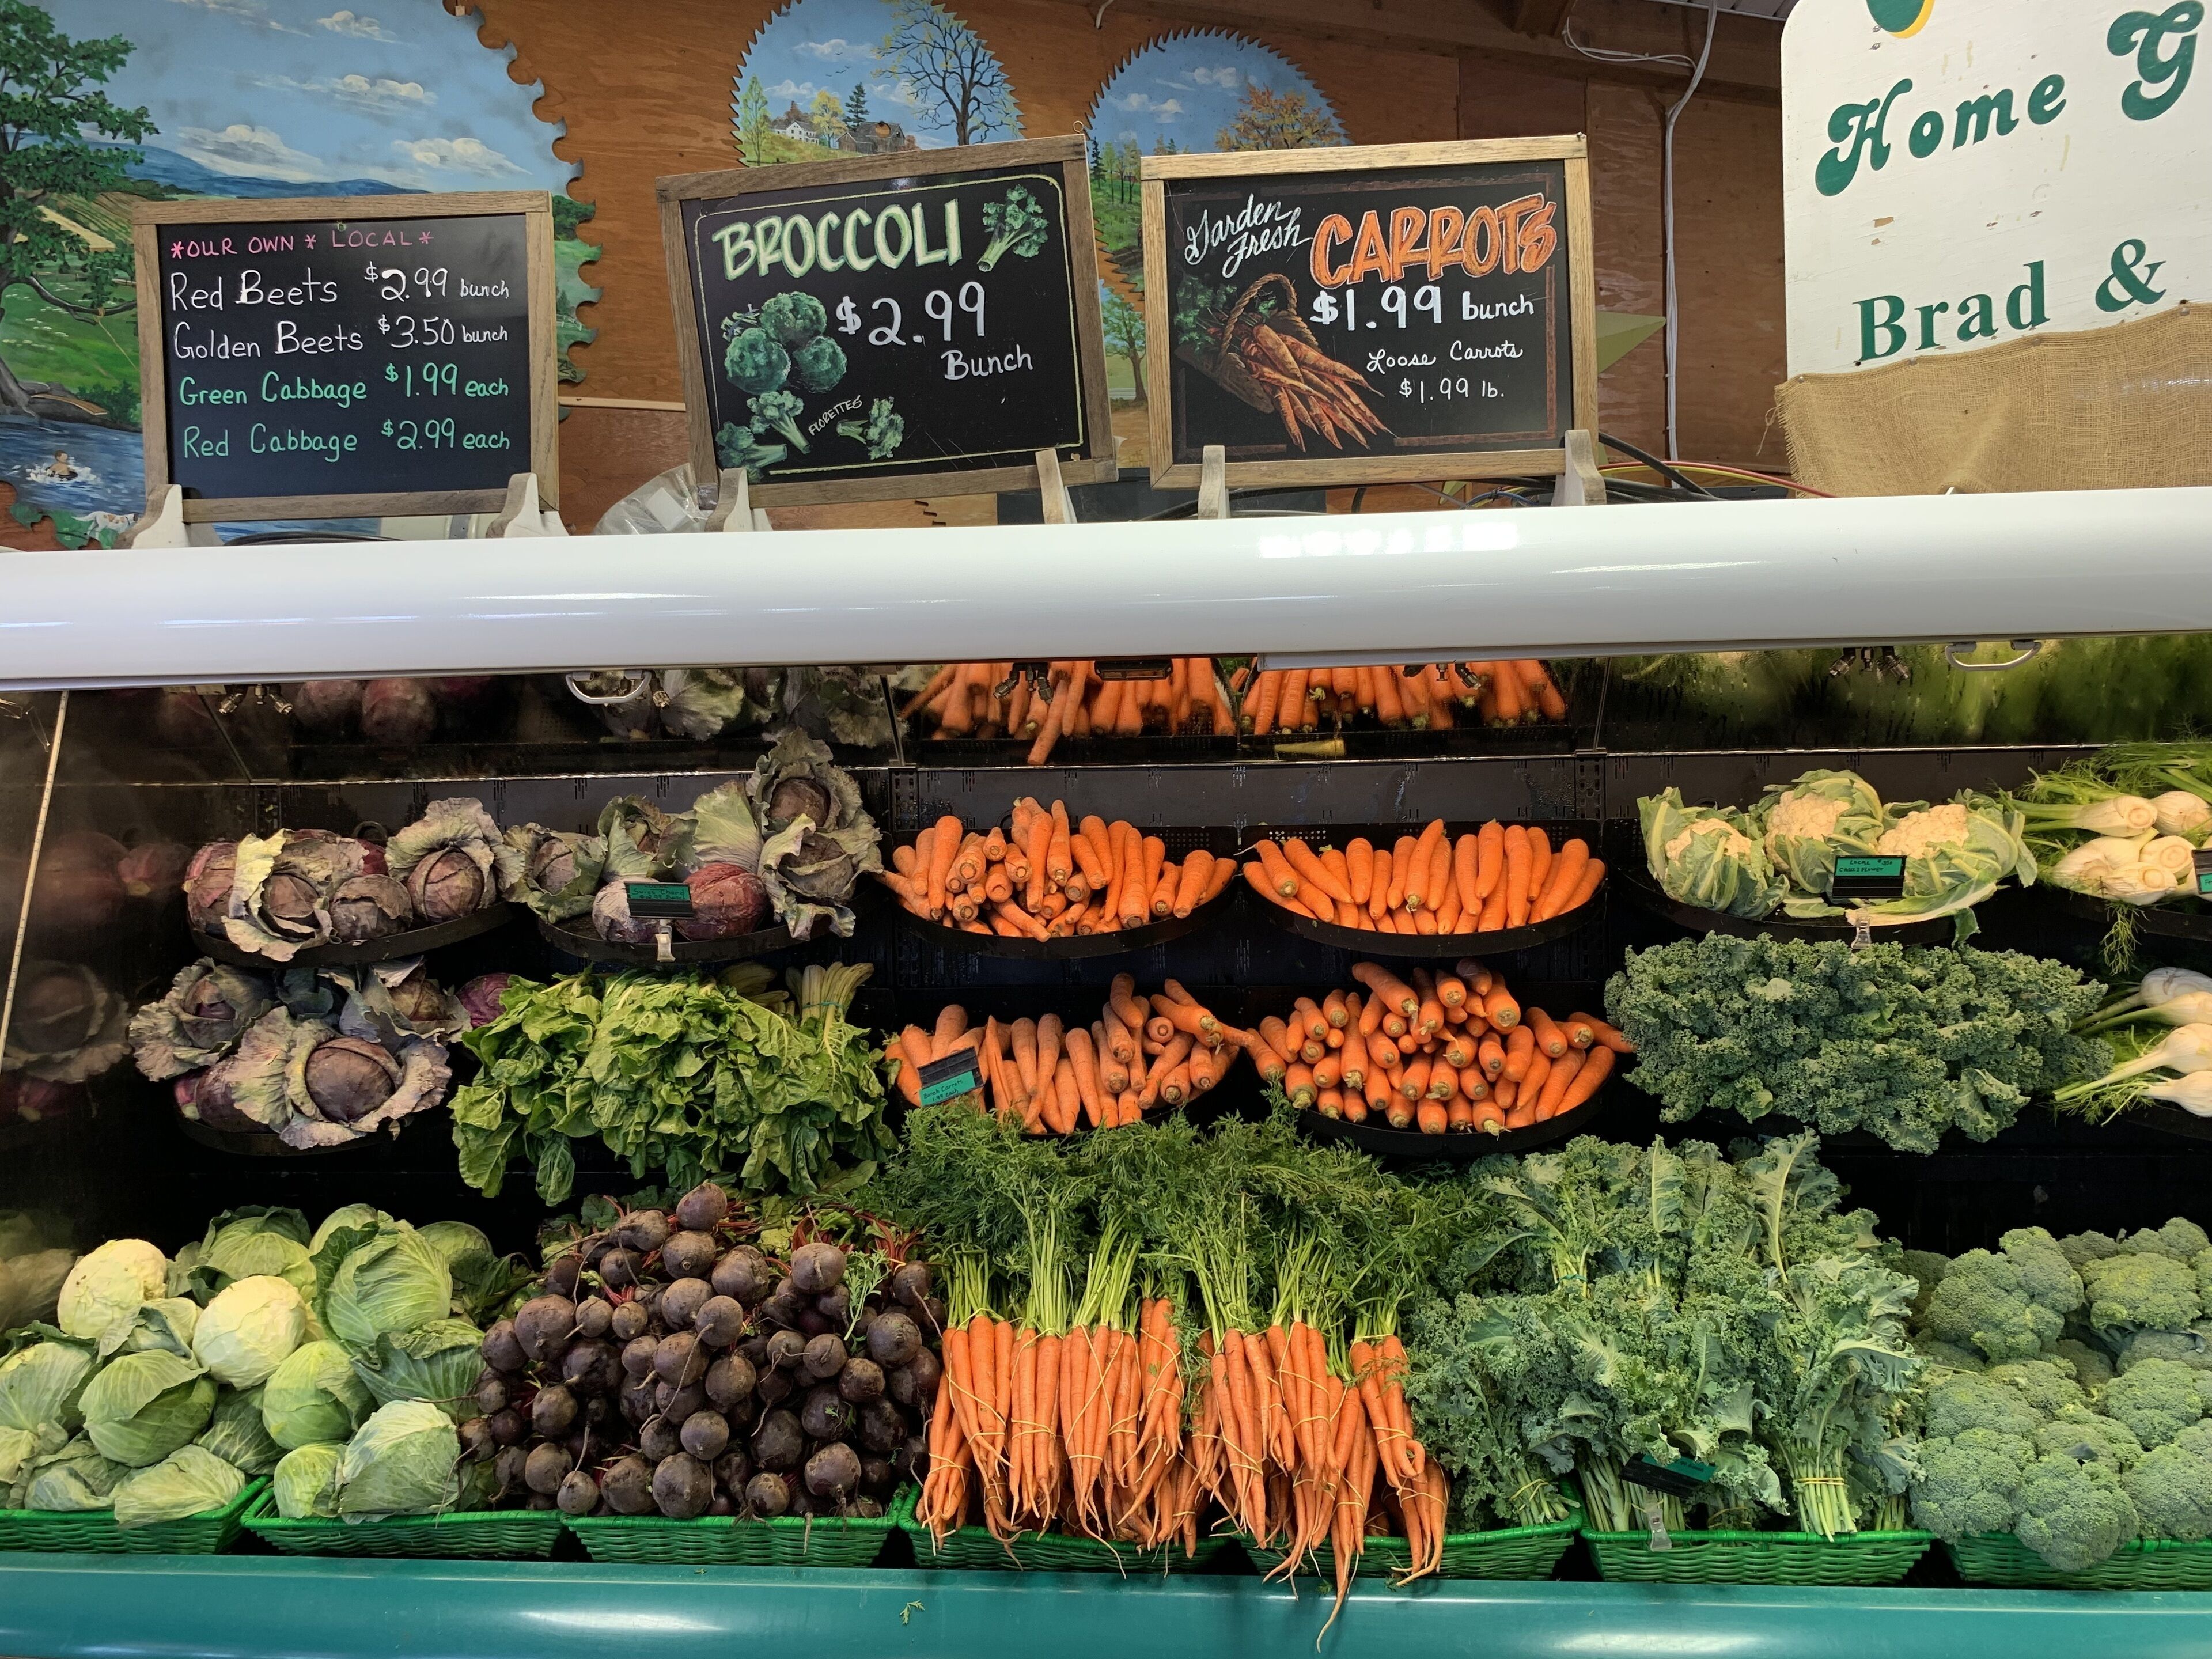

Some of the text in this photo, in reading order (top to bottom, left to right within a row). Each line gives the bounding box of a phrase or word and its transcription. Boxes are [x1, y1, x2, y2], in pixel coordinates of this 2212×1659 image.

[1815, 74, 2067, 196] Home
[248, 236, 294, 253] OWN
[331, 230, 413, 248] LOCAL
[712, 198, 963, 281] BROCCOLI
[1184, 192, 1293, 266] Garden
[1222, 207, 1314, 279] Fresh
[1310, 193, 1557, 289] CARROTS
[171, 260, 510, 312] Red Beets $2.99 bunch
[1310, 285, 1534, 331] $1.99 bunch
[1852, 238, 2167, 362] Brad &
[174, 314, 507, 359] Golden Beets $3.50 bunch
[836, 281, 985, 347] $2.99
[940, 344, 1033, 381] Bunch
[1366, 340, 1523, 375] Loose Carrots
[179, 363, 509, 408] Green Cabbage $1.99 each
[1399, 377, 1505, 404] $1.99 lb.
[808, 395, 863, 436] FLORETTES
[184, 418, 510, 463] Red Cabbage $2.99 each
